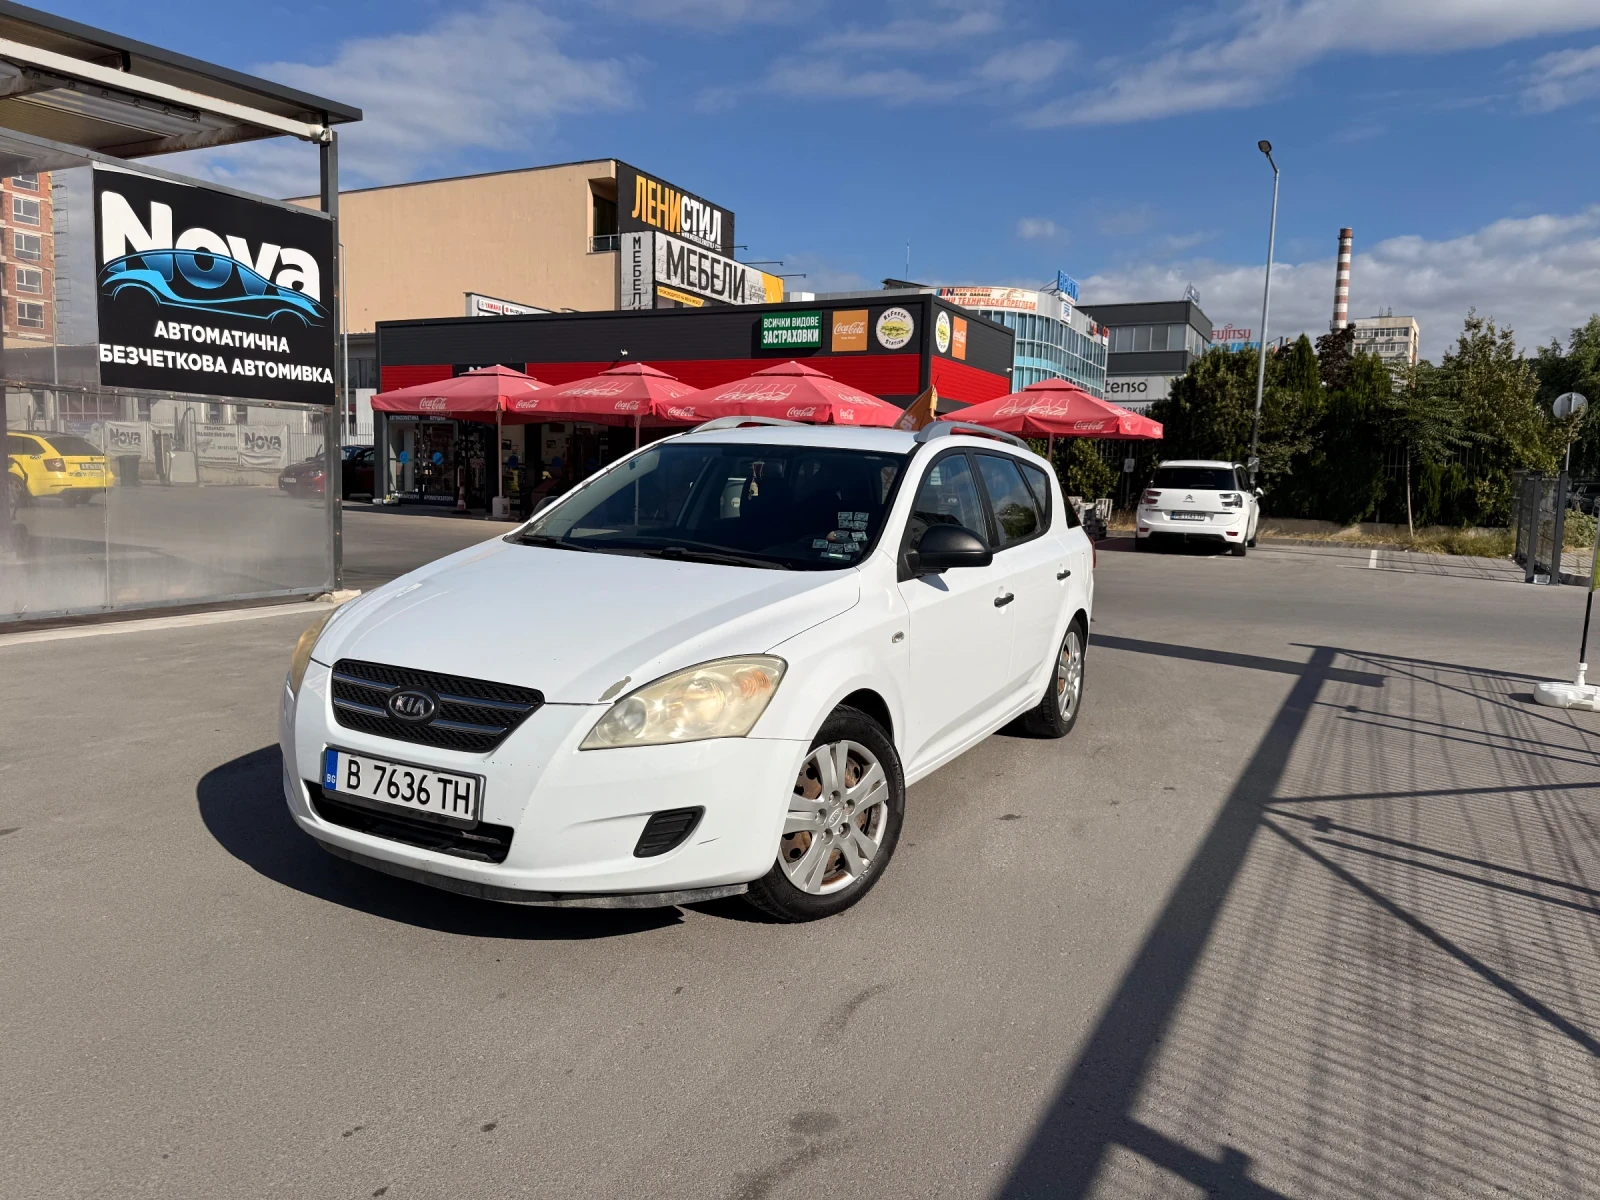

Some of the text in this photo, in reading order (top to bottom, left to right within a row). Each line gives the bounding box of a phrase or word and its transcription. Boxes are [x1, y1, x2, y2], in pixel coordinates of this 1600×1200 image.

[632, 175, 721, 244] ЛЕНИСТИЛ
[101, 190, 320, 302] Nova
[632, 236, 641, 310] МЕБЕЛ
[666, 240, 746, 303] МЕБЕЛИ
[485, 302, 501, 311] YAMAHA
[958, 297, 1005, 306] ТЕХНИЧЕСКИ
[763, 317, 819, 328] ВСИЧКИ ВИДОВЕ
[154, 320, 290, 353] АВТОМАТИЧНА
[763, 329, 819, 344] ЗАСТРАХОВКИ
[1211, 329, 1251, 342] FUJITSU
[100, 344, 334, 384] БЕЗЧЕТКОВА АВТОМИВКА
[110, 428, 141, 444] Nova
[244, 432, 281, 449] Nova
[395, 694, 425, 716] KIA
[326, 774, 336, 784] BG
[346, 759, 471, 814] B 7636 TH
